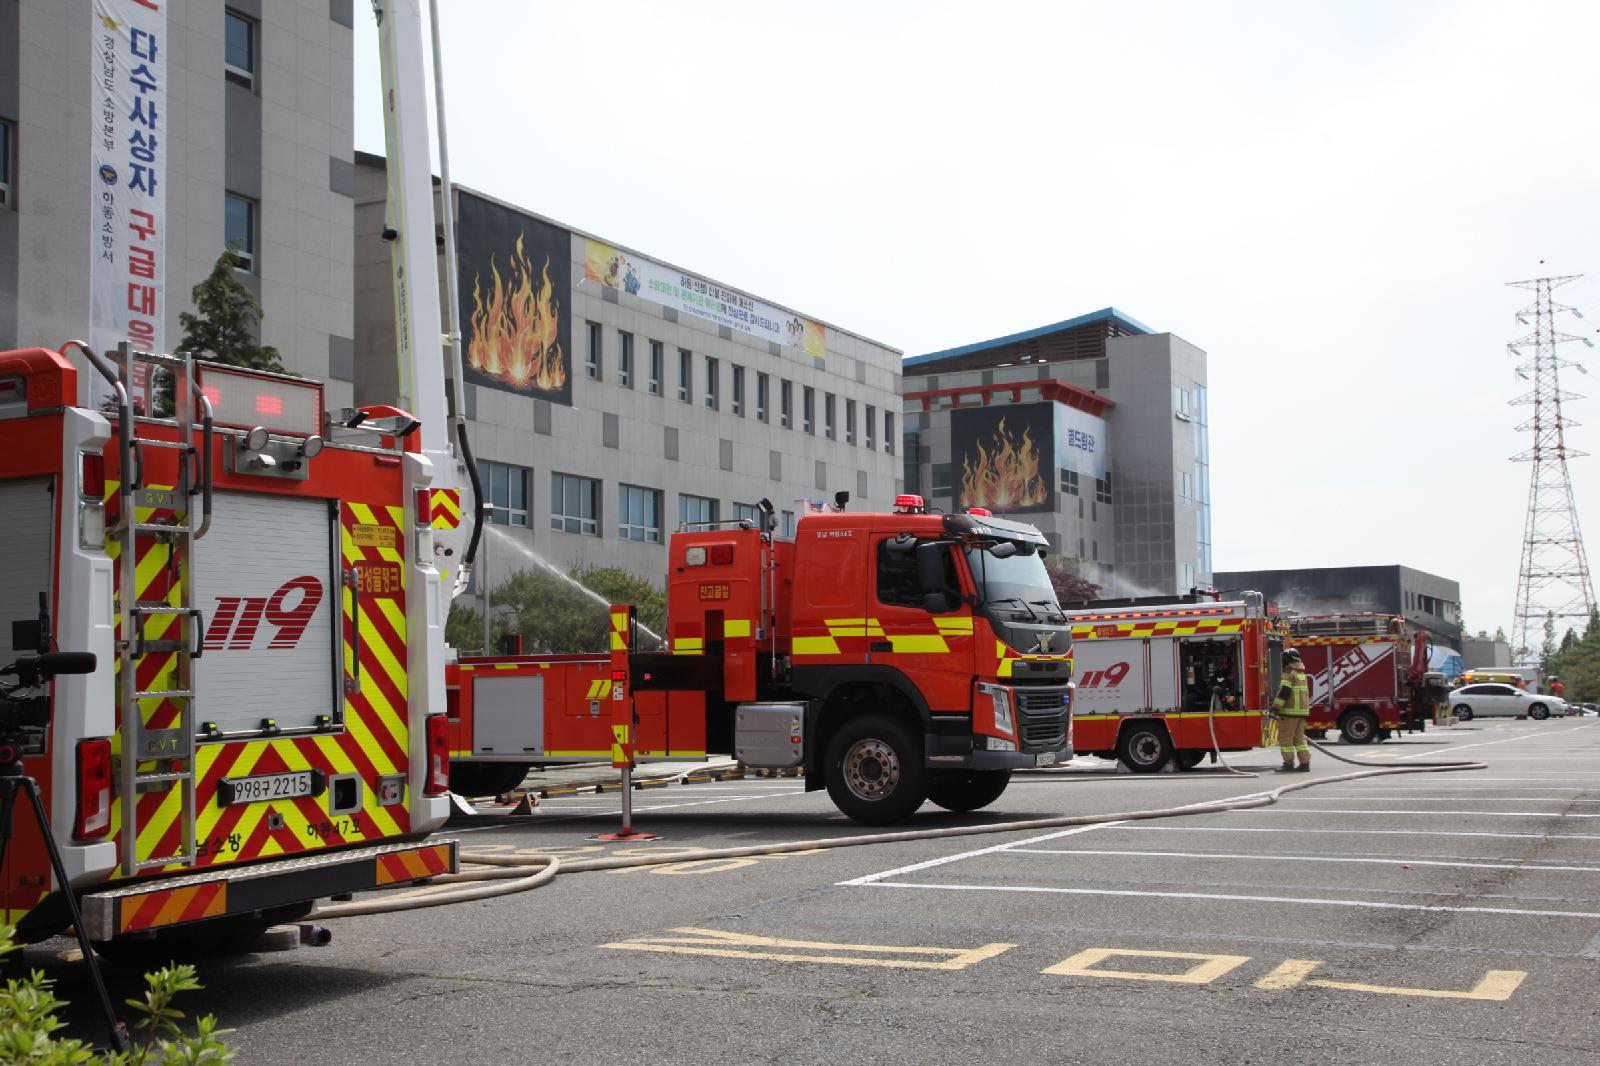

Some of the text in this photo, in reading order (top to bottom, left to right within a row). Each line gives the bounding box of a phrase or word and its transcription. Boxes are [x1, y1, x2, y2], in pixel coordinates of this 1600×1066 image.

[128, 26, 158, 197] 다수사상자
[102, 191, 114, 264] 하동소방서
[727, 305, 749, 323] 진심으로
[749, 313, 780, 332] 감사드립니다
[202, 575, 323, 650] 119
[1078, 661, 1130, 688] 119
[235, 775, 307, 800] 998구 2215
